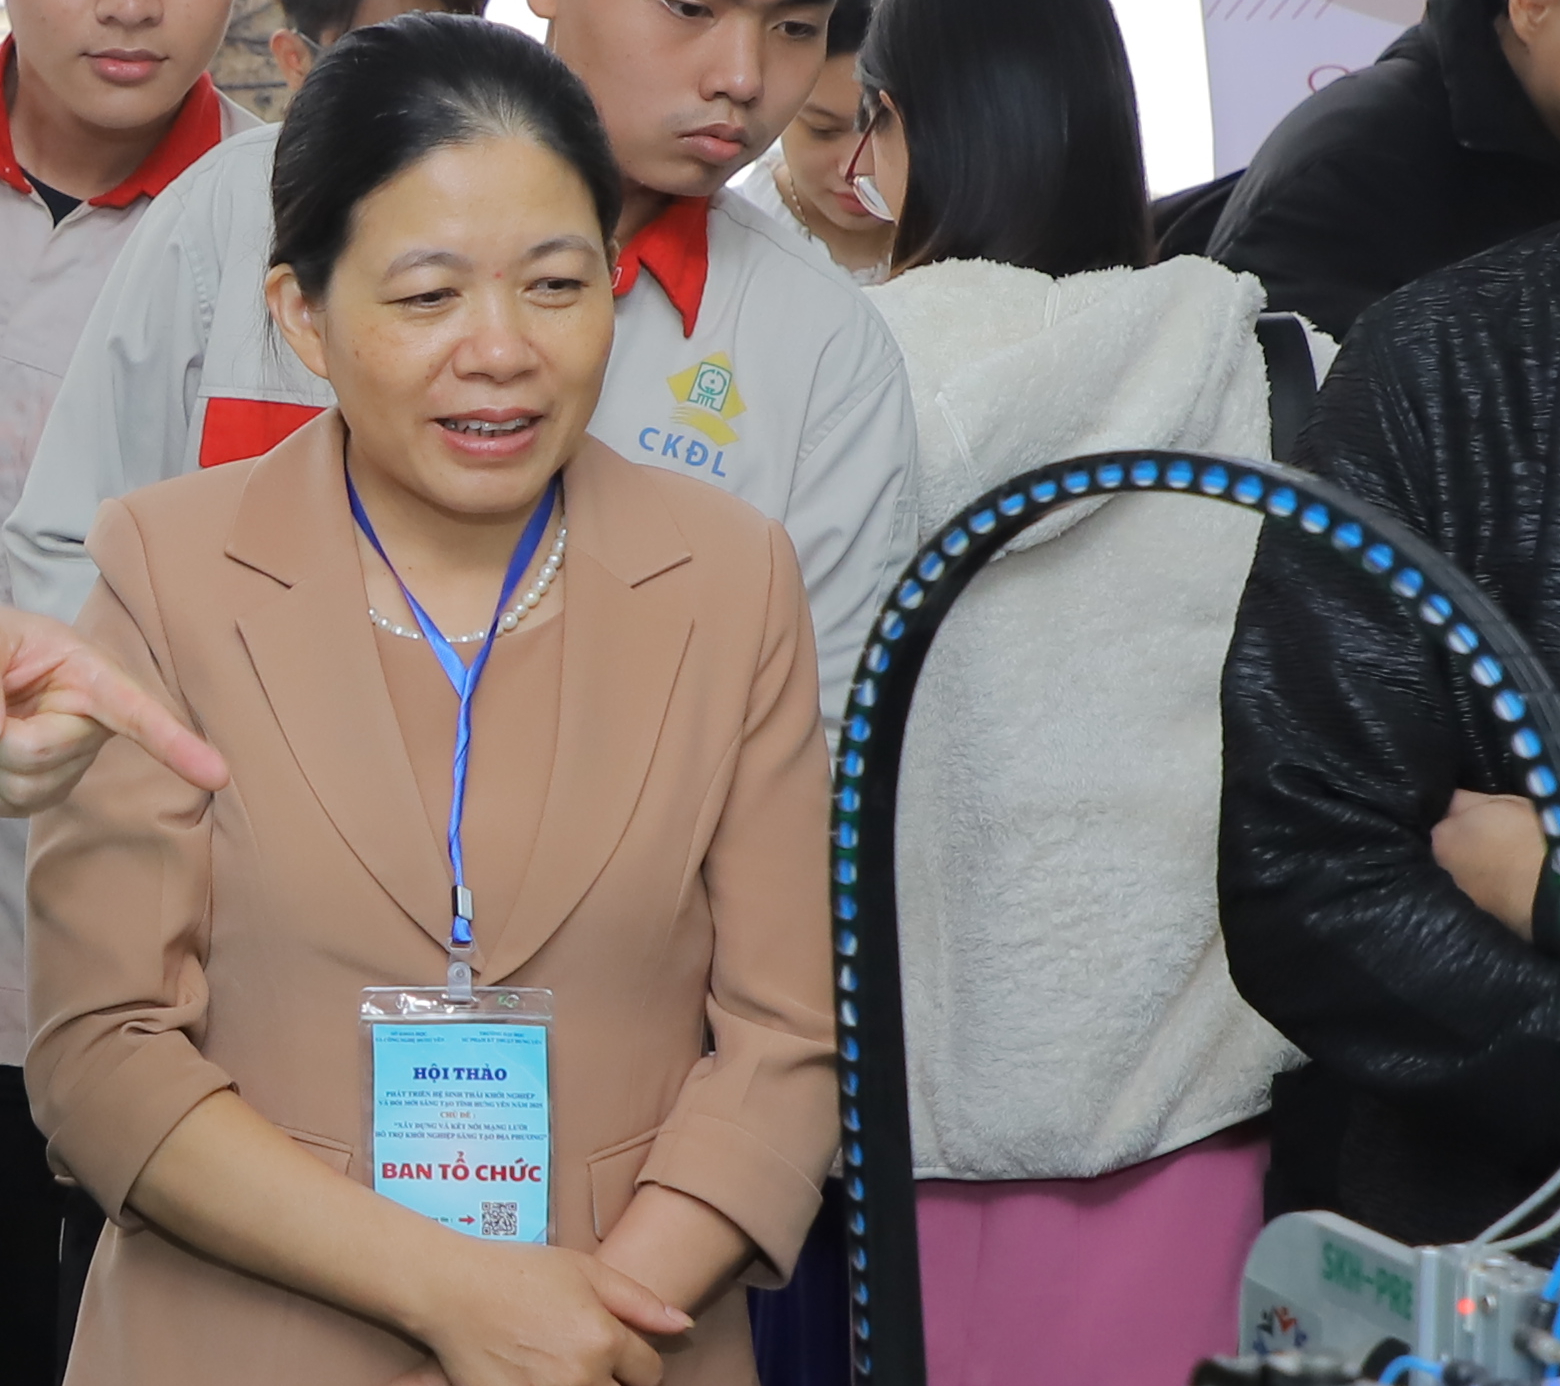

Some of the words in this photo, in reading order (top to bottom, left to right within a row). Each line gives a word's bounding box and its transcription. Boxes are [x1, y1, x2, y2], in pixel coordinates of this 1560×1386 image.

[638, 426, 727, 478] CKĐL
[413, 1063, 449, 1083] HỘI
[453, 1063, 507, 1081] THẢO
[382, 1162, 432, 1180] BAN
[438, 1151, 470, 1181] TỔ
[475, 1157, 542, 1182] CHỨC
